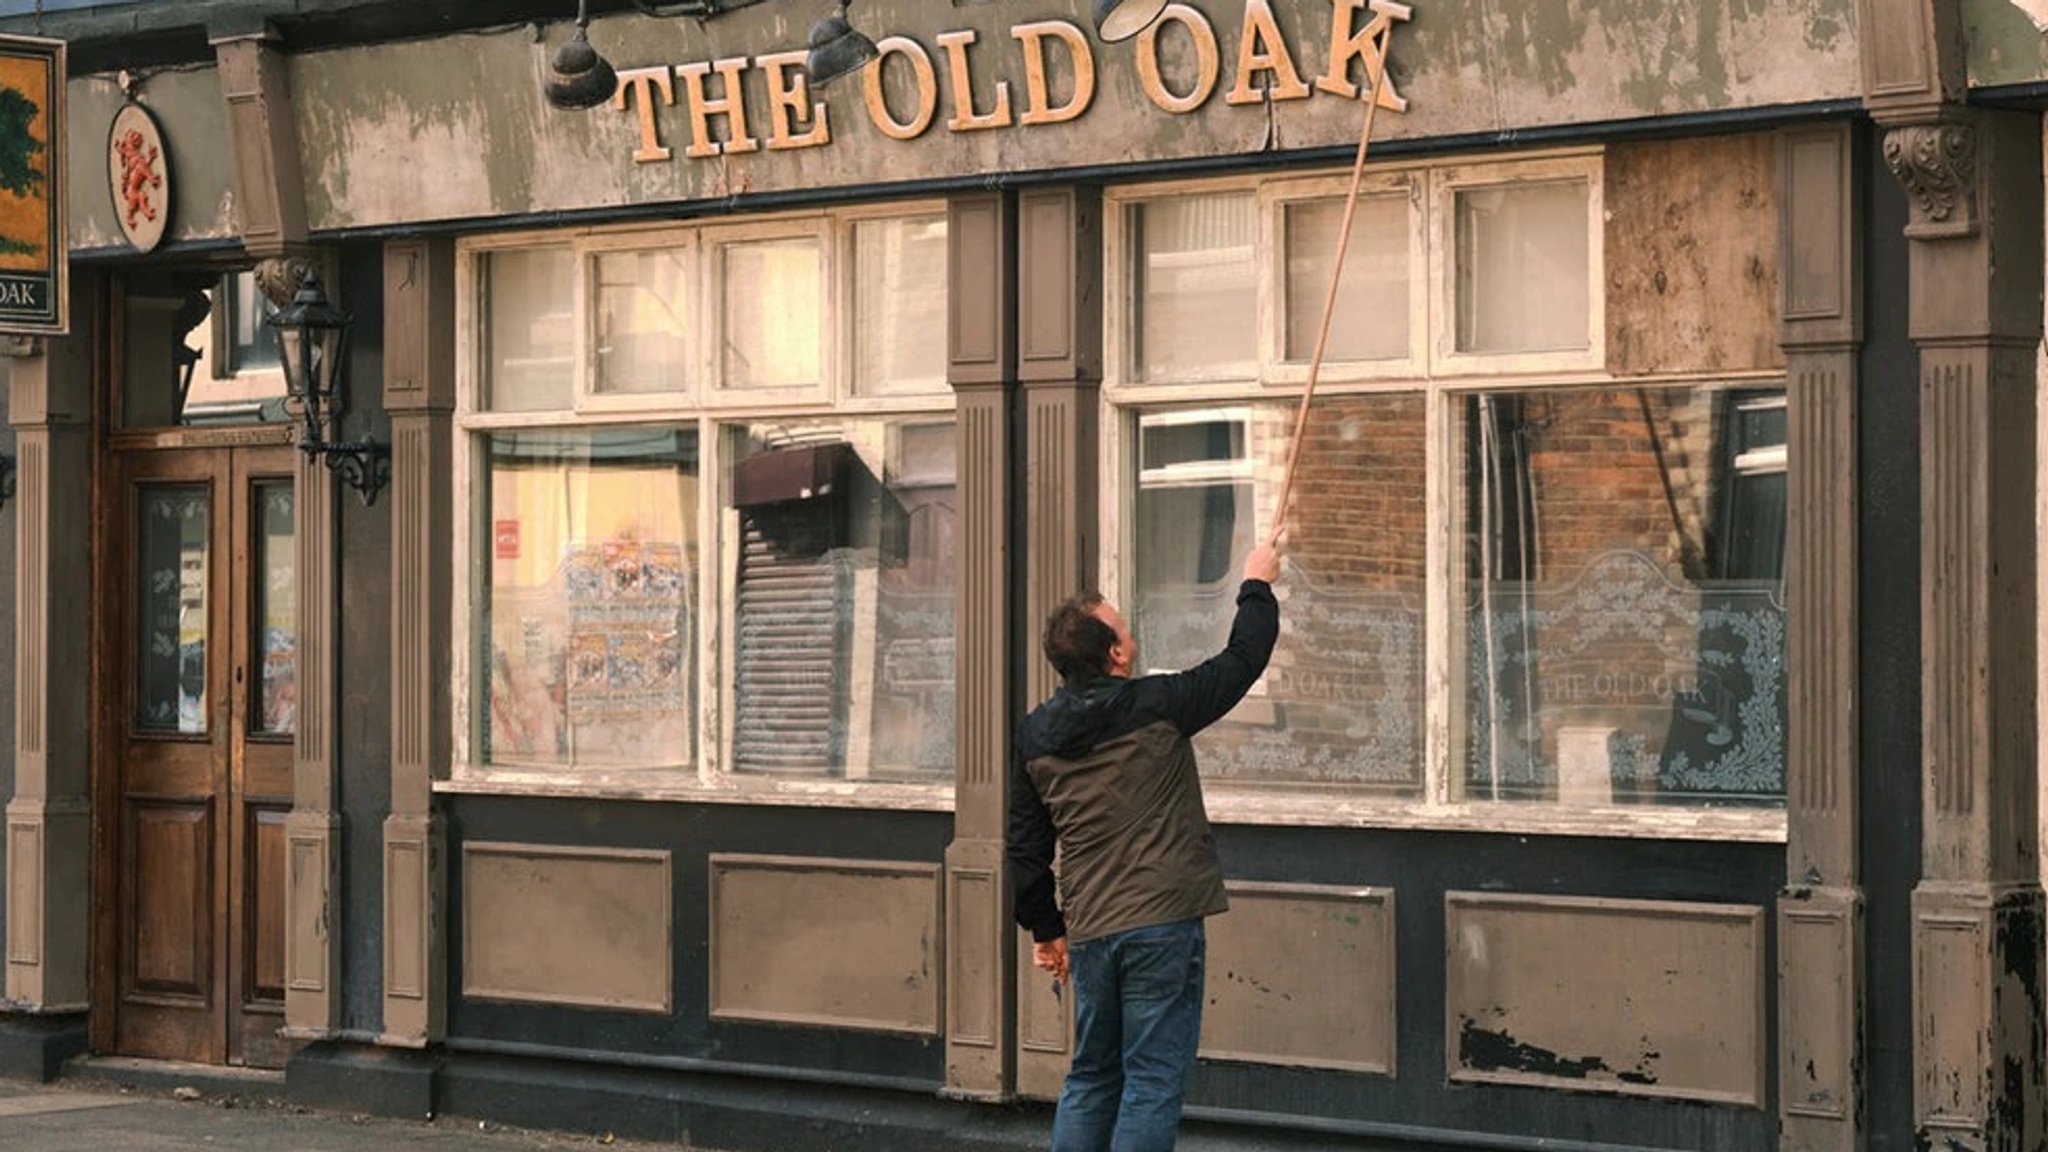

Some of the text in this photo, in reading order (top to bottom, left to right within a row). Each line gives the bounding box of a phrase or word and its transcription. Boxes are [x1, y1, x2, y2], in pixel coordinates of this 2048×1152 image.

[615, 0, 1413, 163] THE OLD OAK
